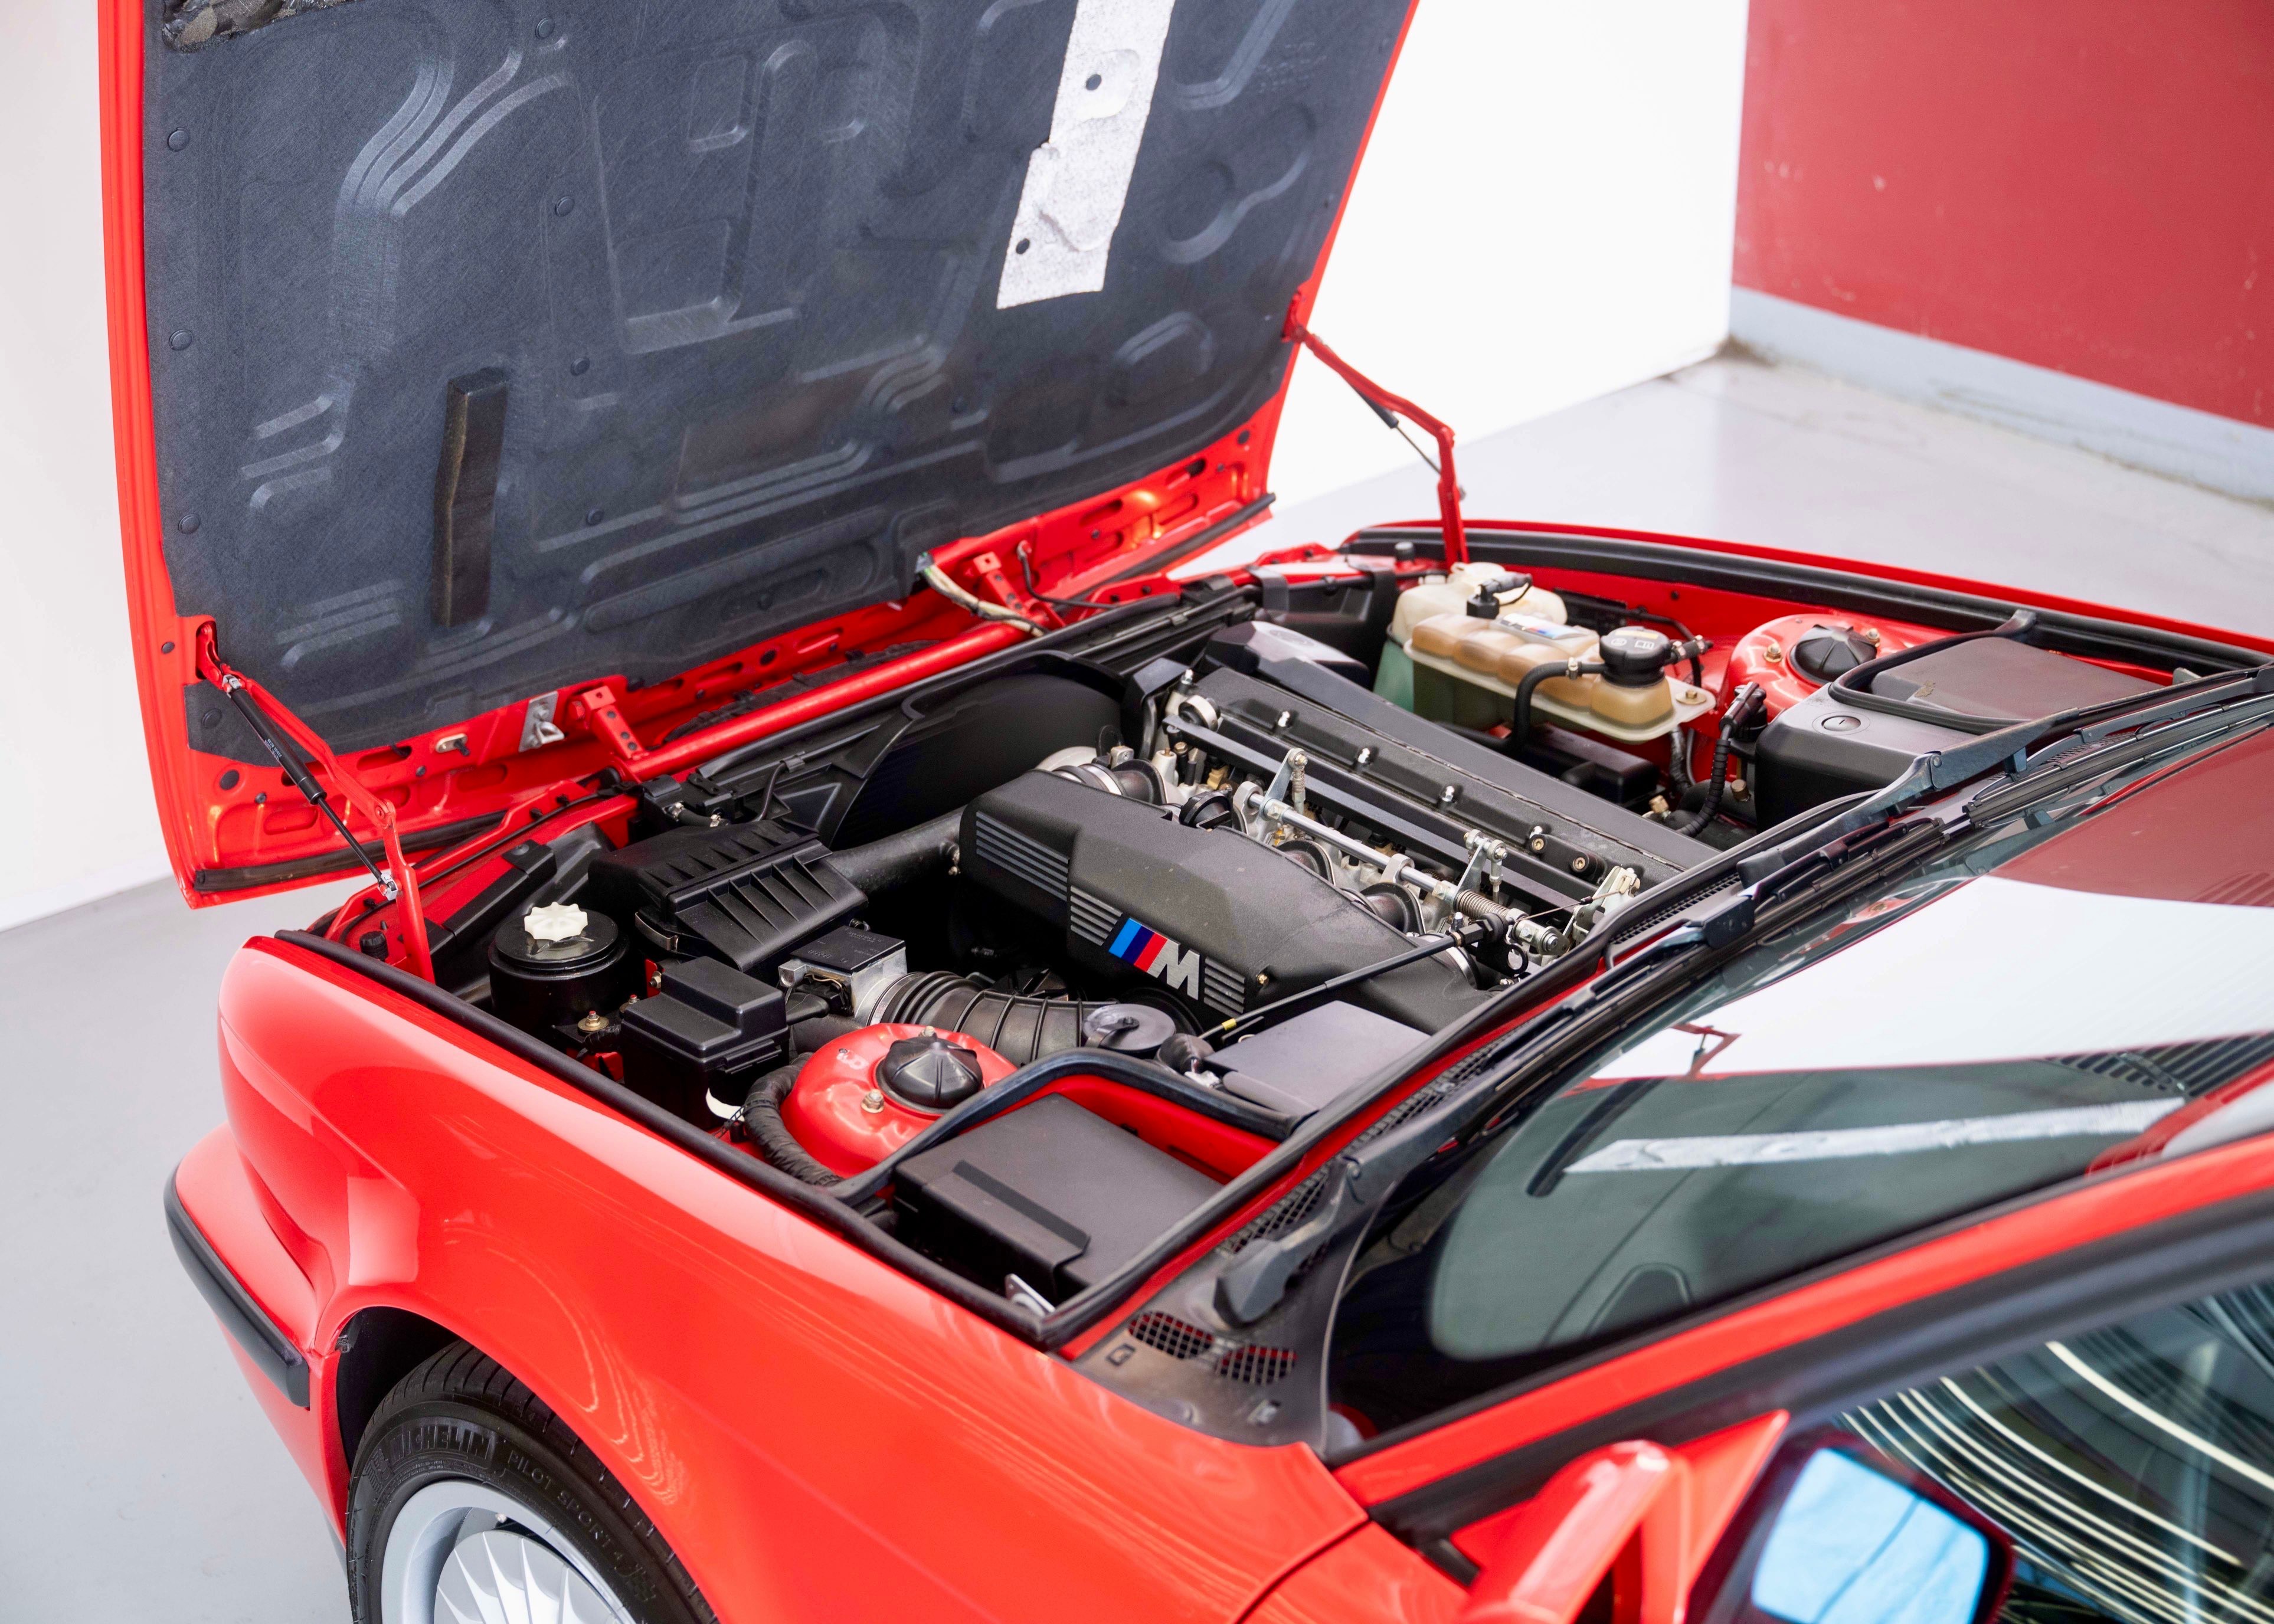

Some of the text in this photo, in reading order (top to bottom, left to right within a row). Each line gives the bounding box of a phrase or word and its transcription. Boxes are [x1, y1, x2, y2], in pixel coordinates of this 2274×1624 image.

[1147, 939, 1200, 1000] M
[387, 1425, 492, 1465] MICHELIN
[508, 1450, 553, 1490] PILOT
[557, 1491, 611, 1547] SPORT
